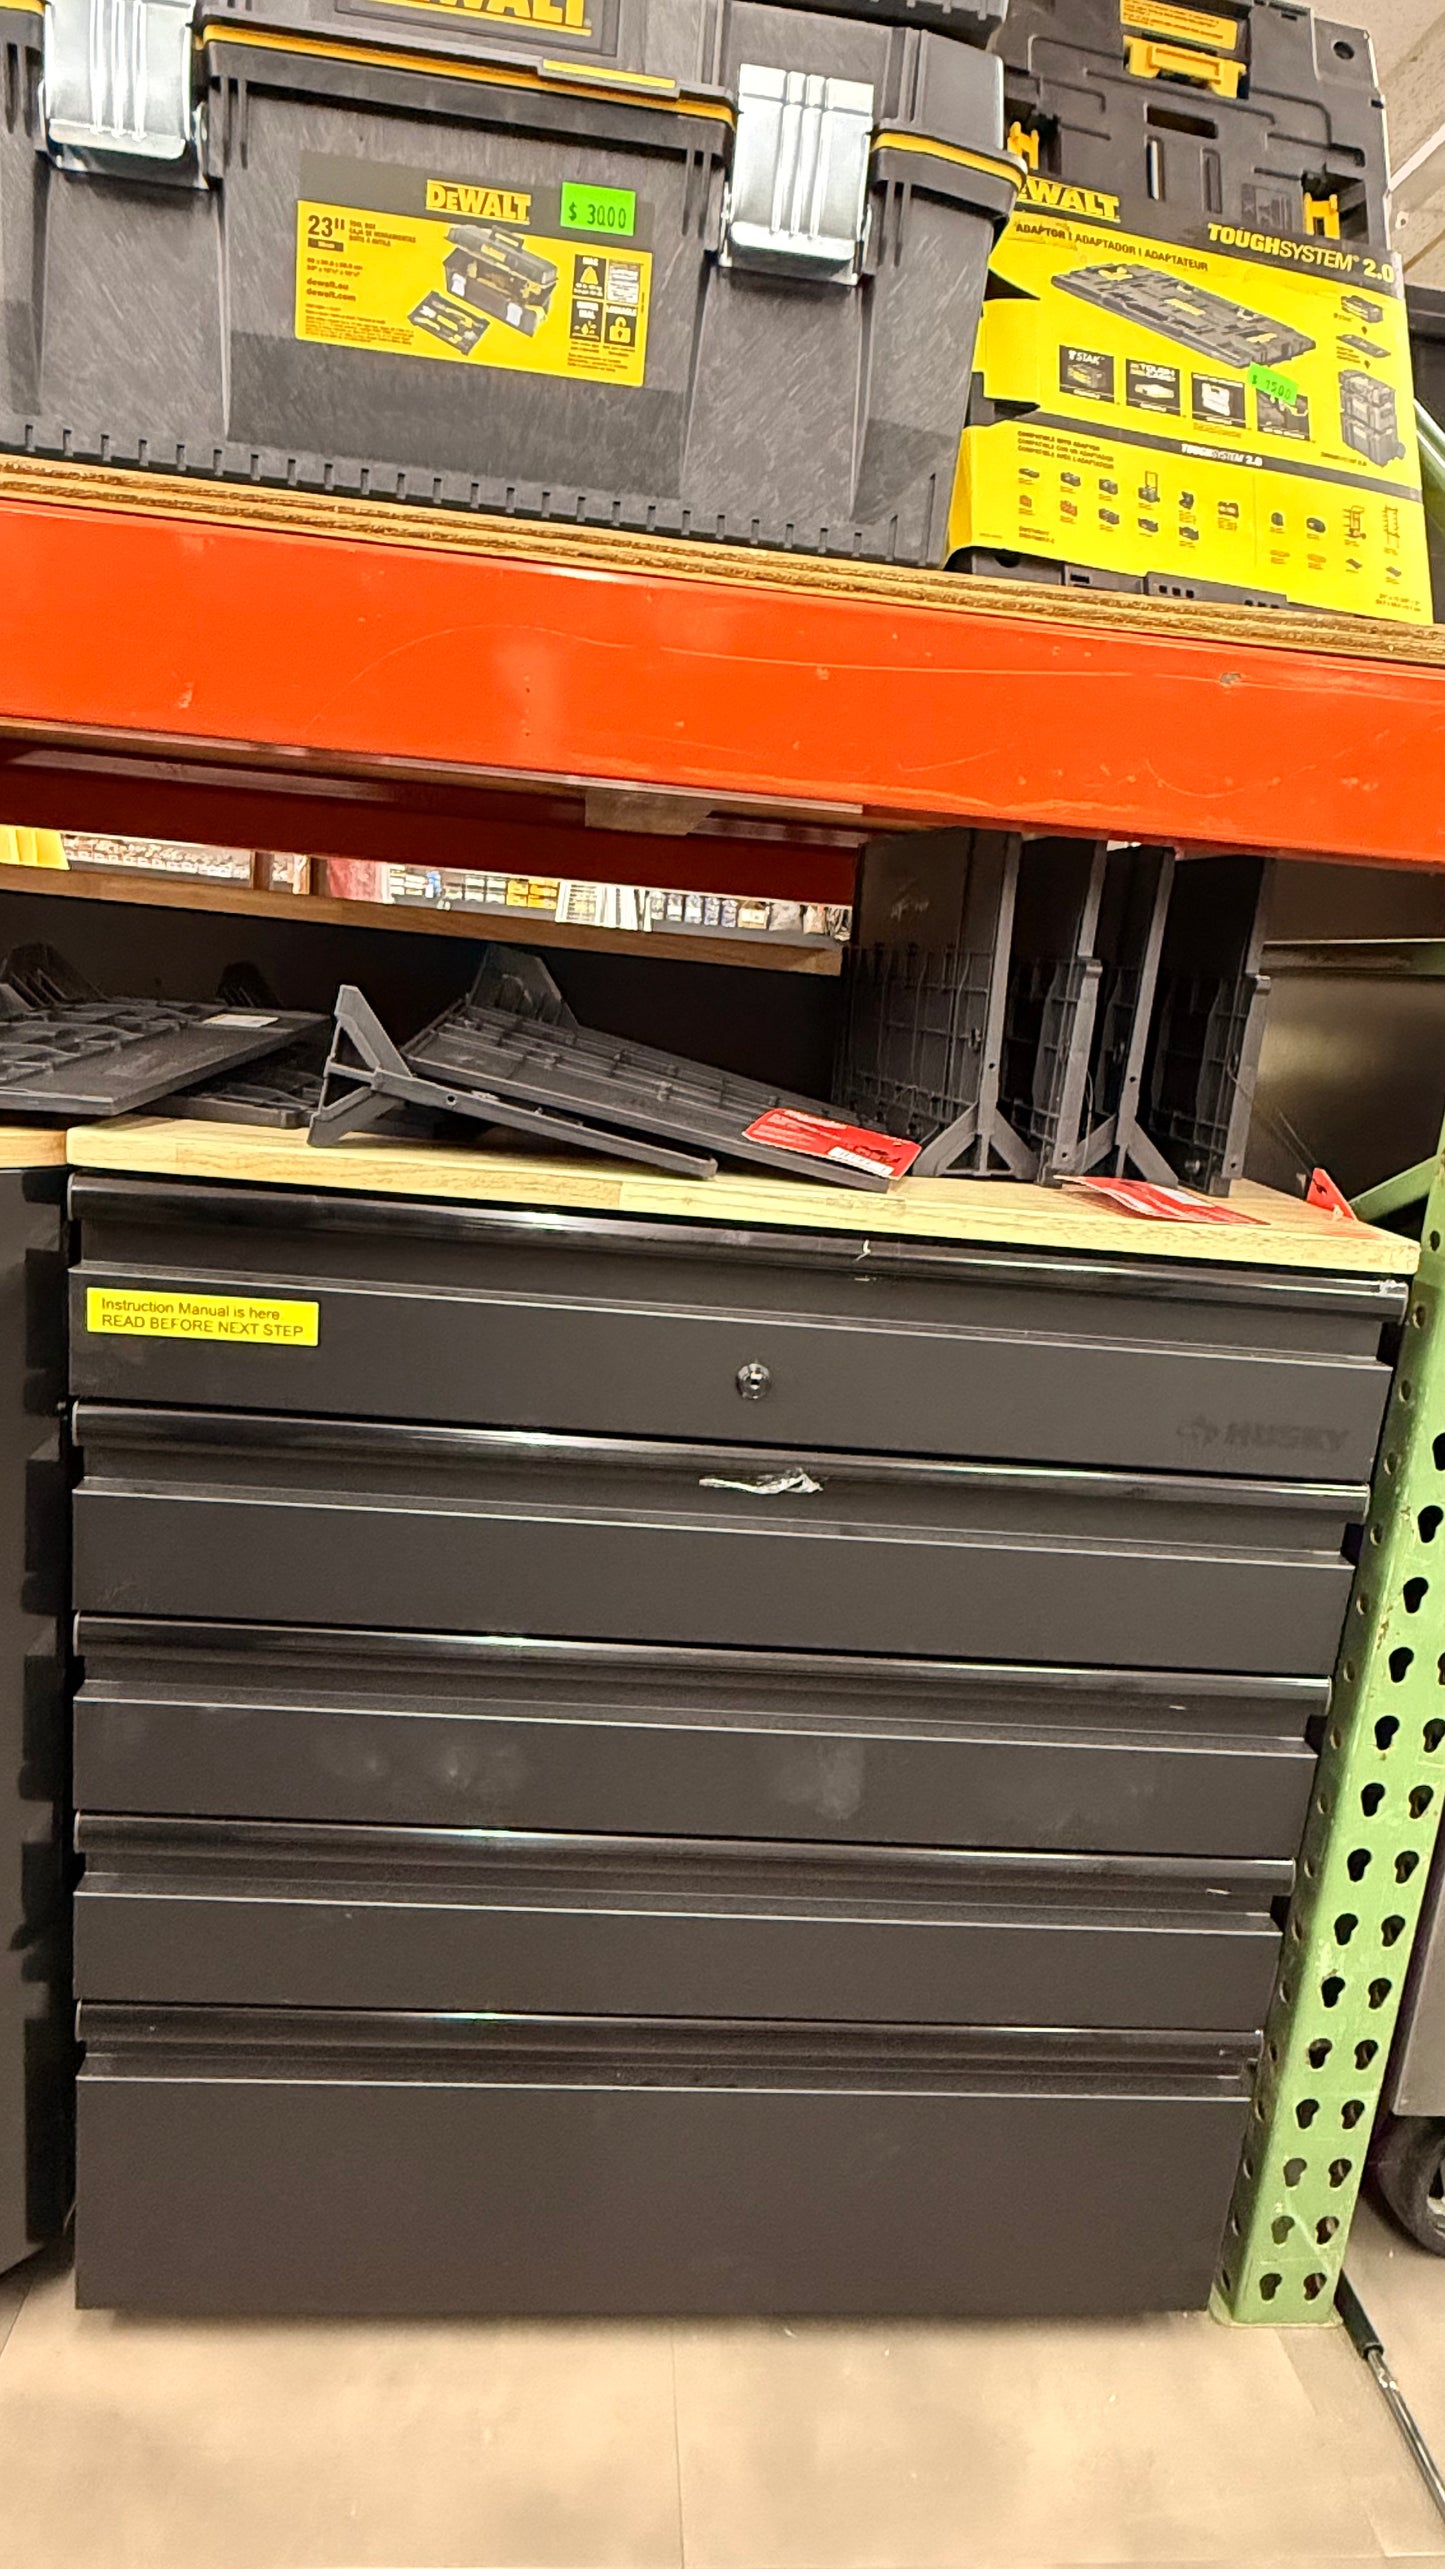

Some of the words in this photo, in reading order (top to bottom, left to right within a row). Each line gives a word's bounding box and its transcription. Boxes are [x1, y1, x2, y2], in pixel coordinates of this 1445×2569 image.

[568, 201, 578, 222] $
[1015, 223, 1067, 240] ADAPTOR
[1074, 233, 1136, 256] ADAPTADOR
[1144, 249, 1209, 272] ADAPTATEUR
[1362, 258, 1396, 283] 2.0
[306, 288, 357, 302] dewalt.com
[101, 1297, 174, 1314] Instruction
[178, 1301, 229, 1318] Manual
[233, 1305, 245, 1319] is
[249, 1306, 280, 1321] here
[101, 1314, 145, 1329] READ
[150, 1317, 213, 1333] BEFORE
[217, 1321, 259, 1336] NEXT
[263, 1323, 304, 1337] STEP
[1224, 1422, 1350, 1452] HUSKY
